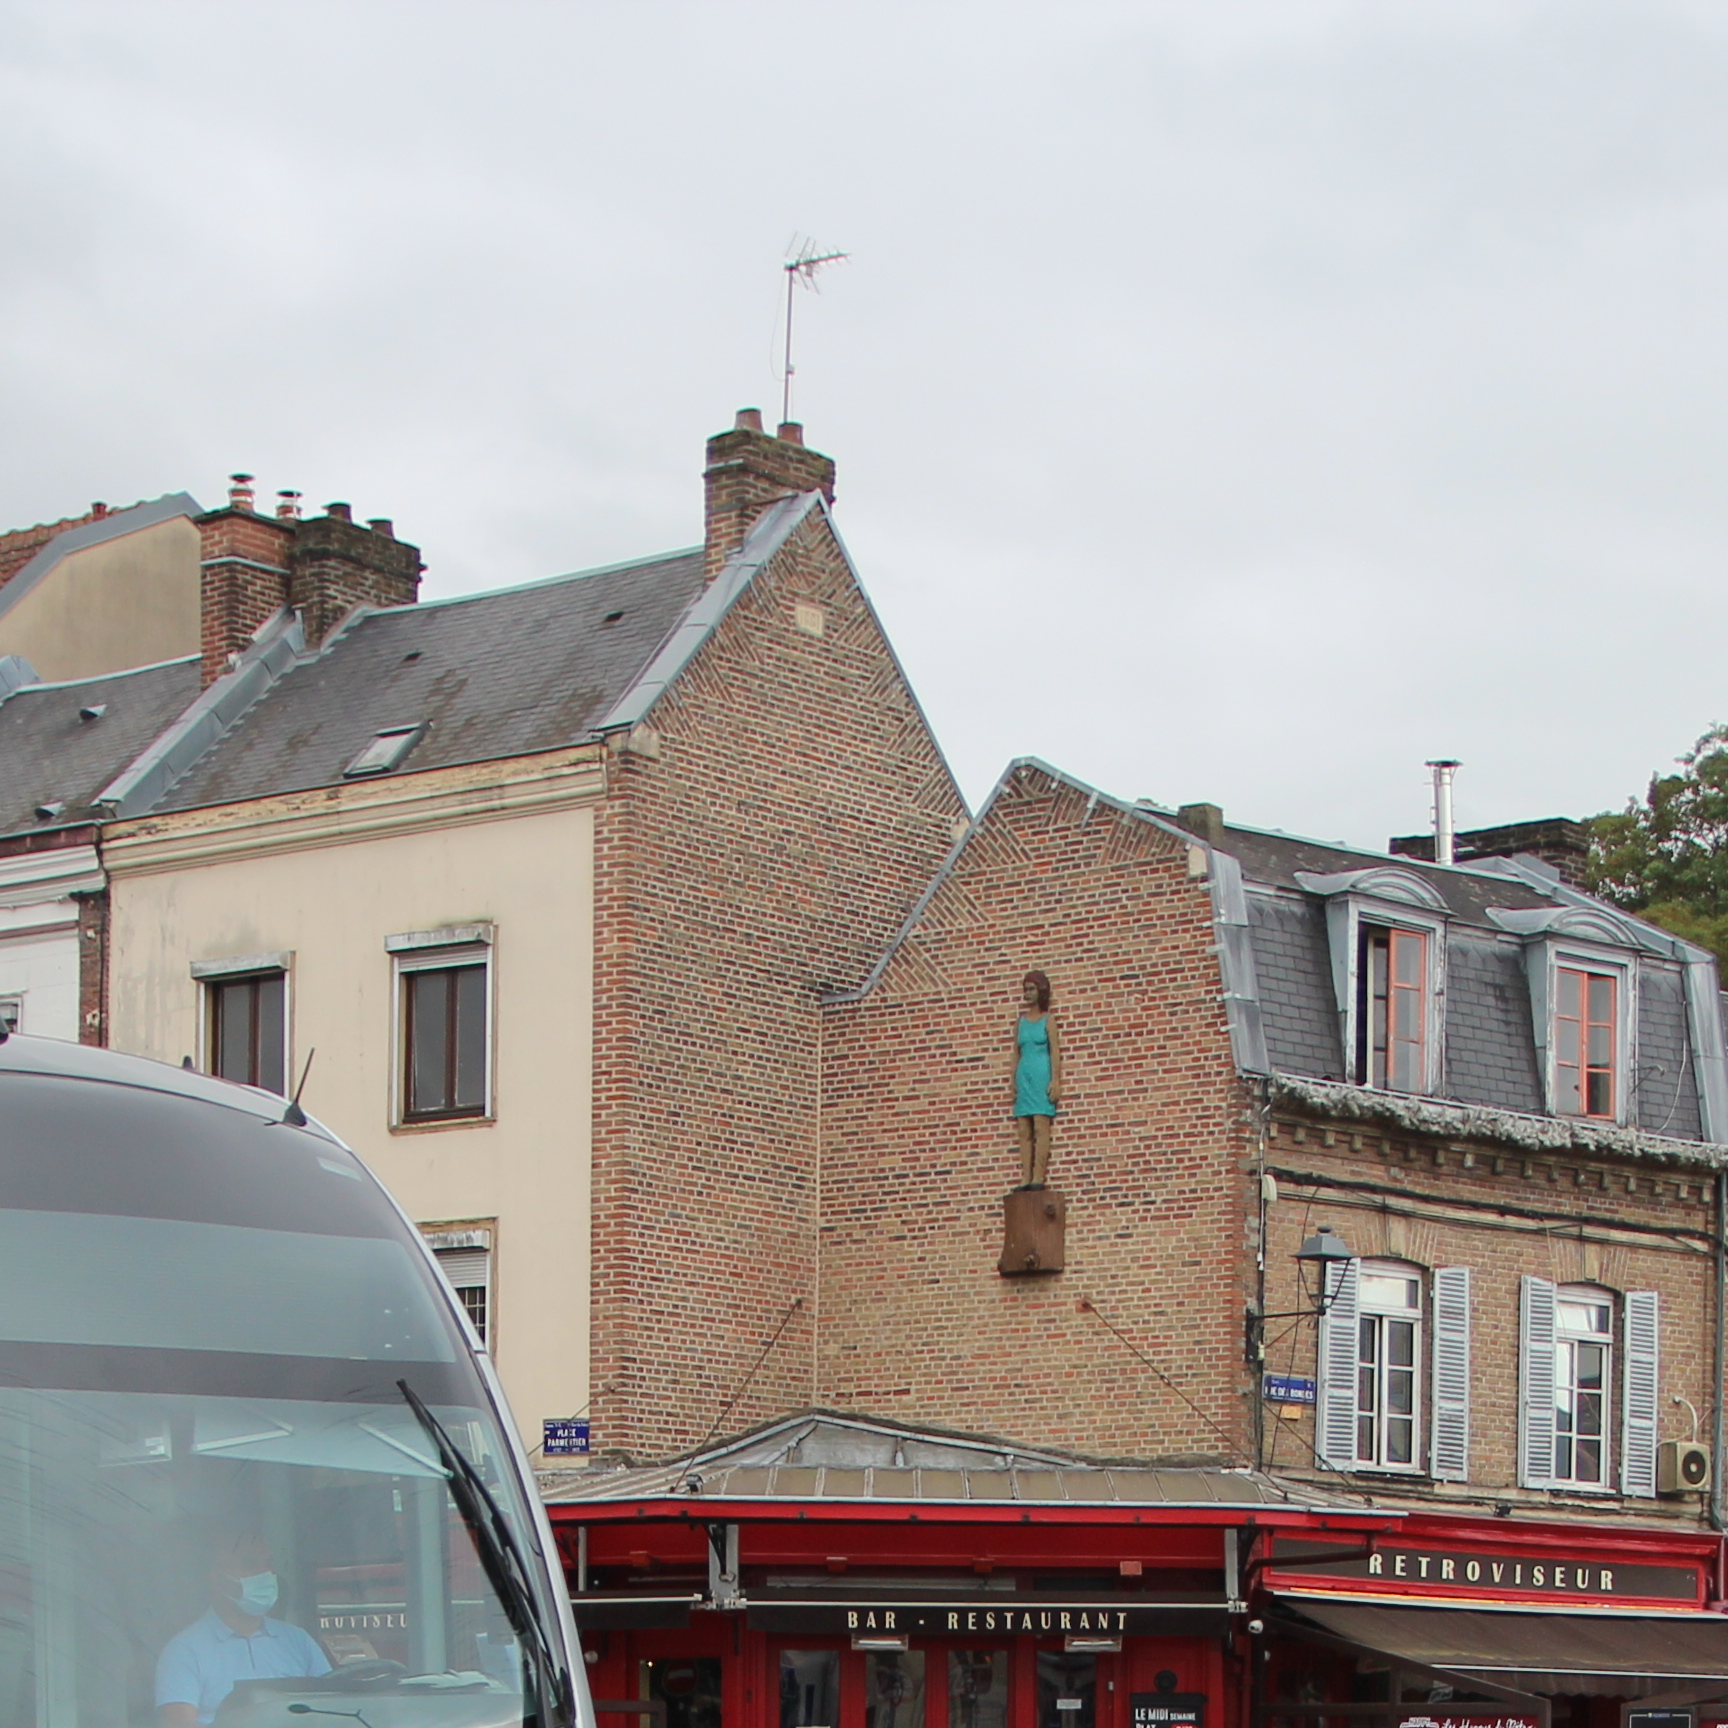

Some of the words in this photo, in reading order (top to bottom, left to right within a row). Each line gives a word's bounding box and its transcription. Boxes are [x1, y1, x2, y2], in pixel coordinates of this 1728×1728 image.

[1368, 1553, 1613, 1590] RETROVISEUR
[847, 1611, 897, 1629] BAR
[947, 1611, 1127, 1630] RESTAURANT
[1135, 1708, 1145, 1720] LE
[1148, 1708, 1169, 1720] MIDI
